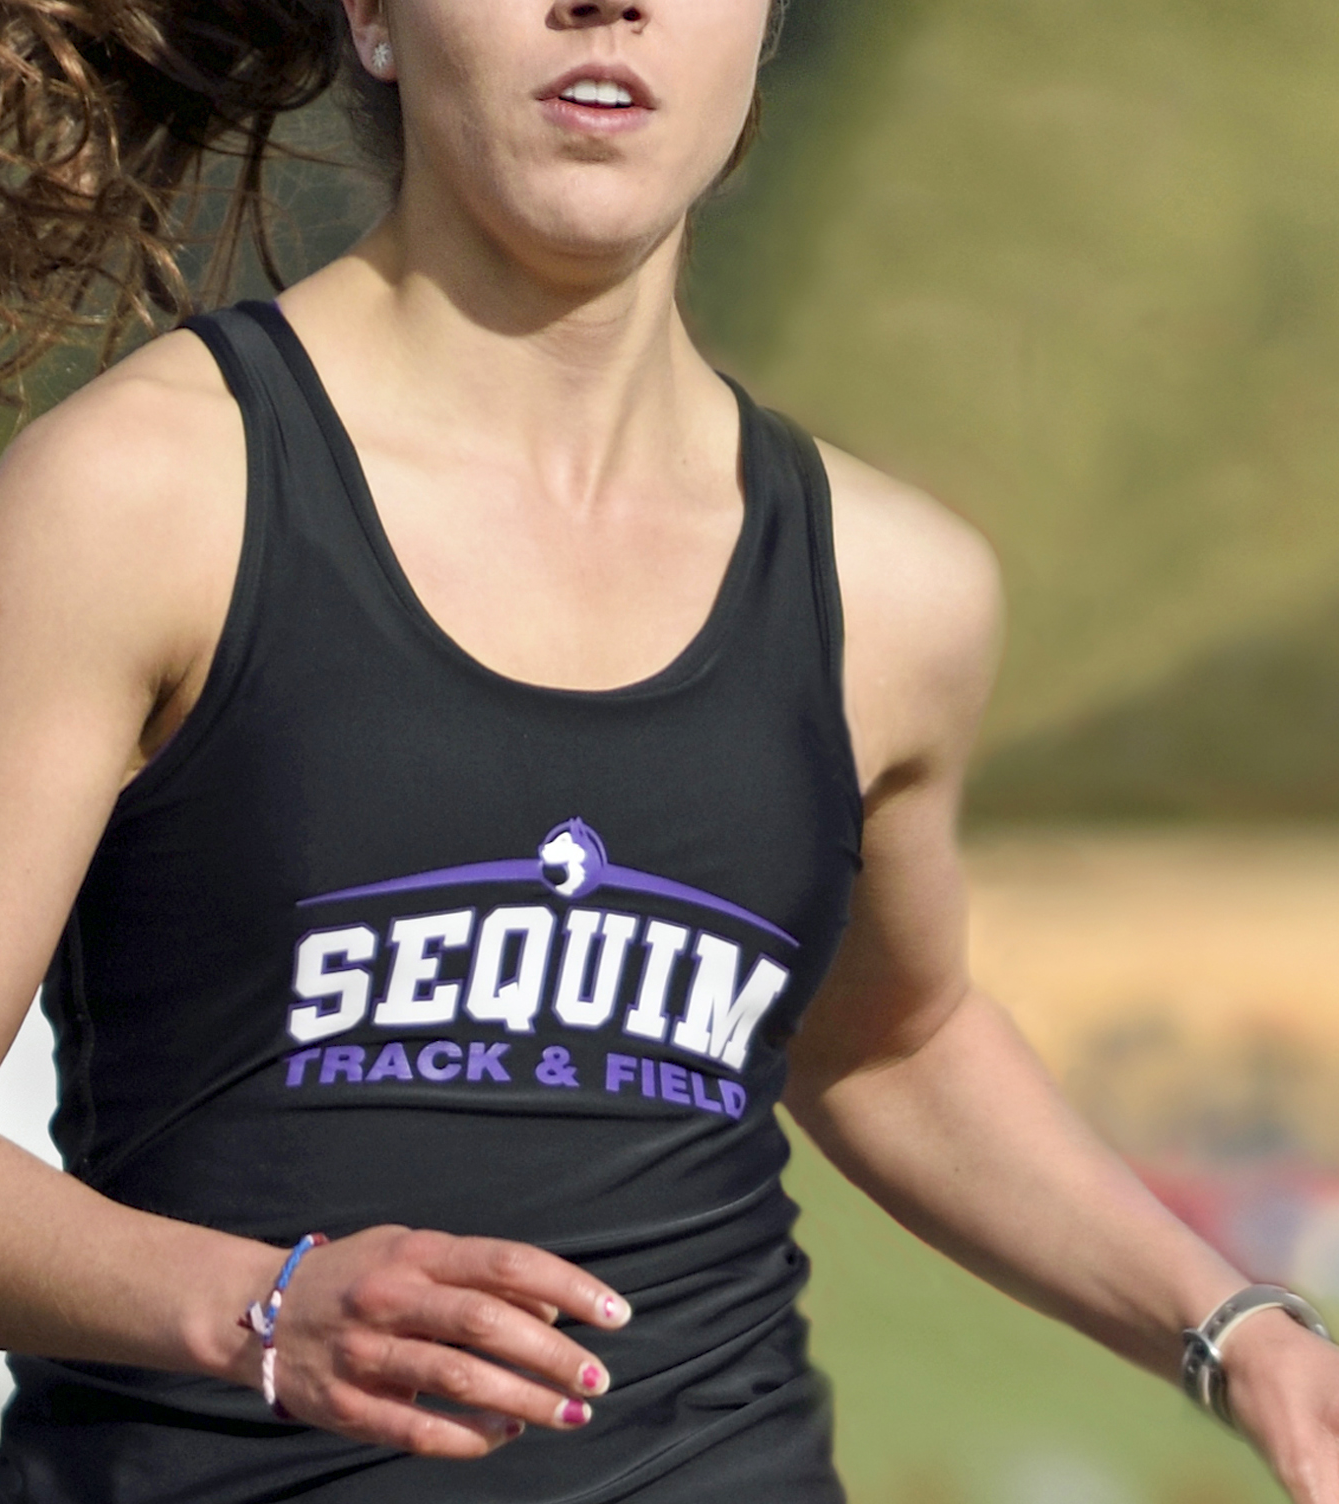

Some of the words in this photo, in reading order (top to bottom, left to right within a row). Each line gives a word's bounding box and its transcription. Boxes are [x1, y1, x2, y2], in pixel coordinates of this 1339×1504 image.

[287, 905, 790, 1071] SEQUIM
[284, 1041, 512, 1087] TRACK
[534, 1045, 580, 1087] &
[605, 1053, 747, 1121] FIELD
